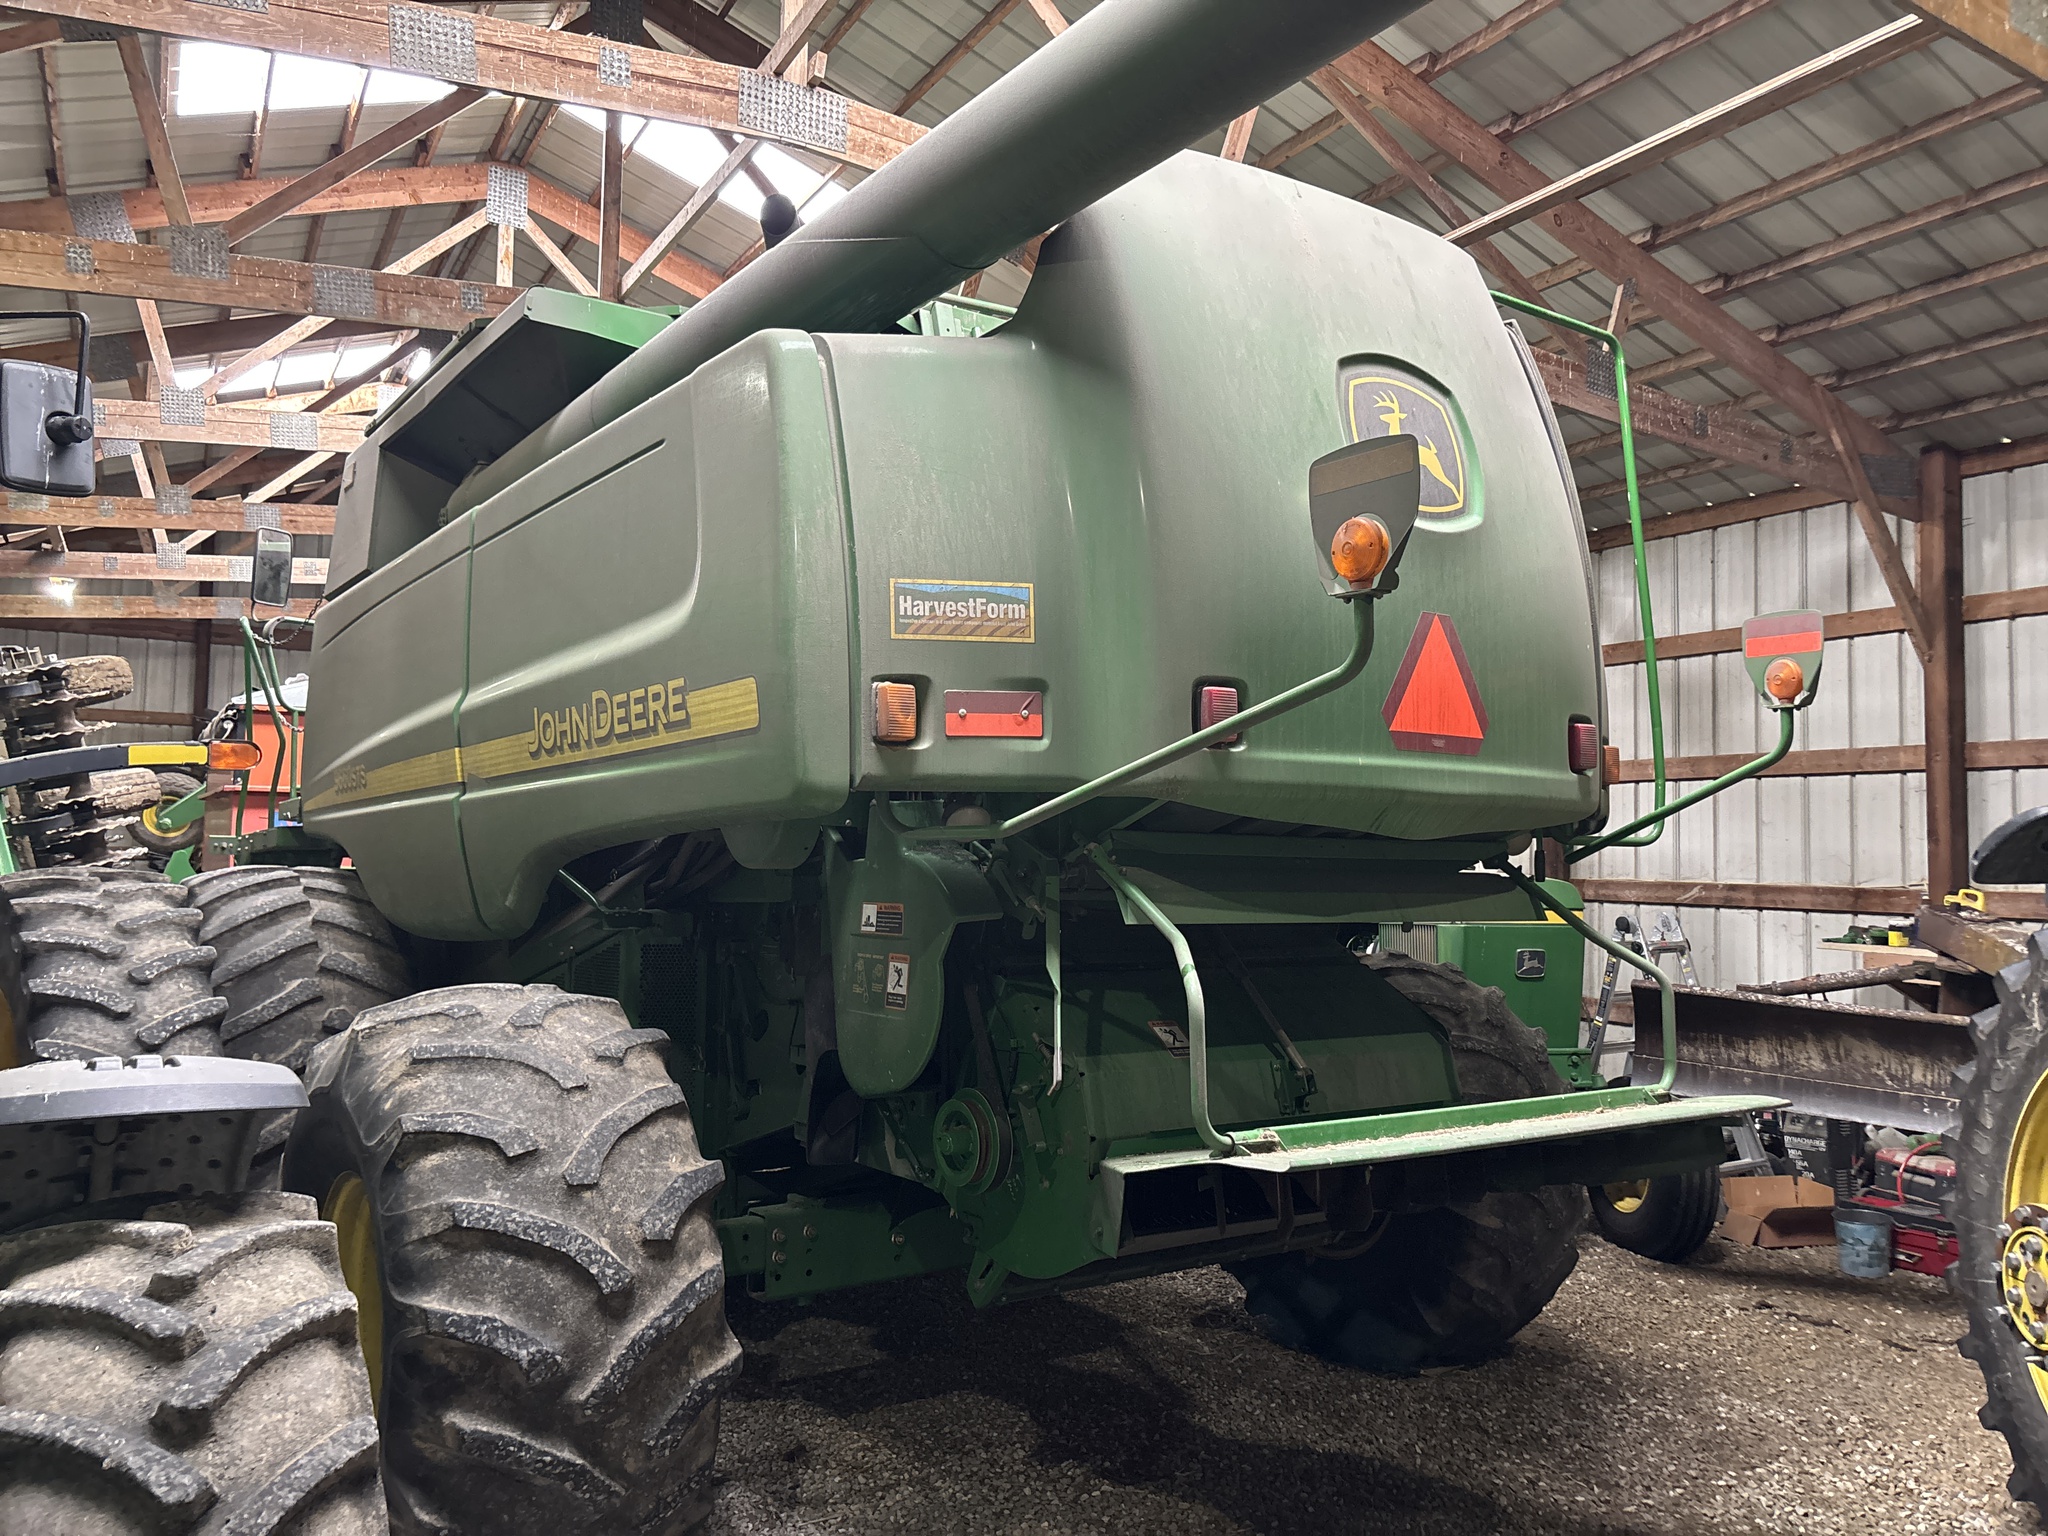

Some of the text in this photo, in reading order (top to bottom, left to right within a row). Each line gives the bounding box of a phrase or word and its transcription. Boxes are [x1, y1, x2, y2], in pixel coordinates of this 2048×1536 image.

[899, 595, 1026, 619] HarvestForm
[528, 676, 690, 757] JOHN DEERE
[1784, 1135, 1827, 1147] DYNACHARGE
